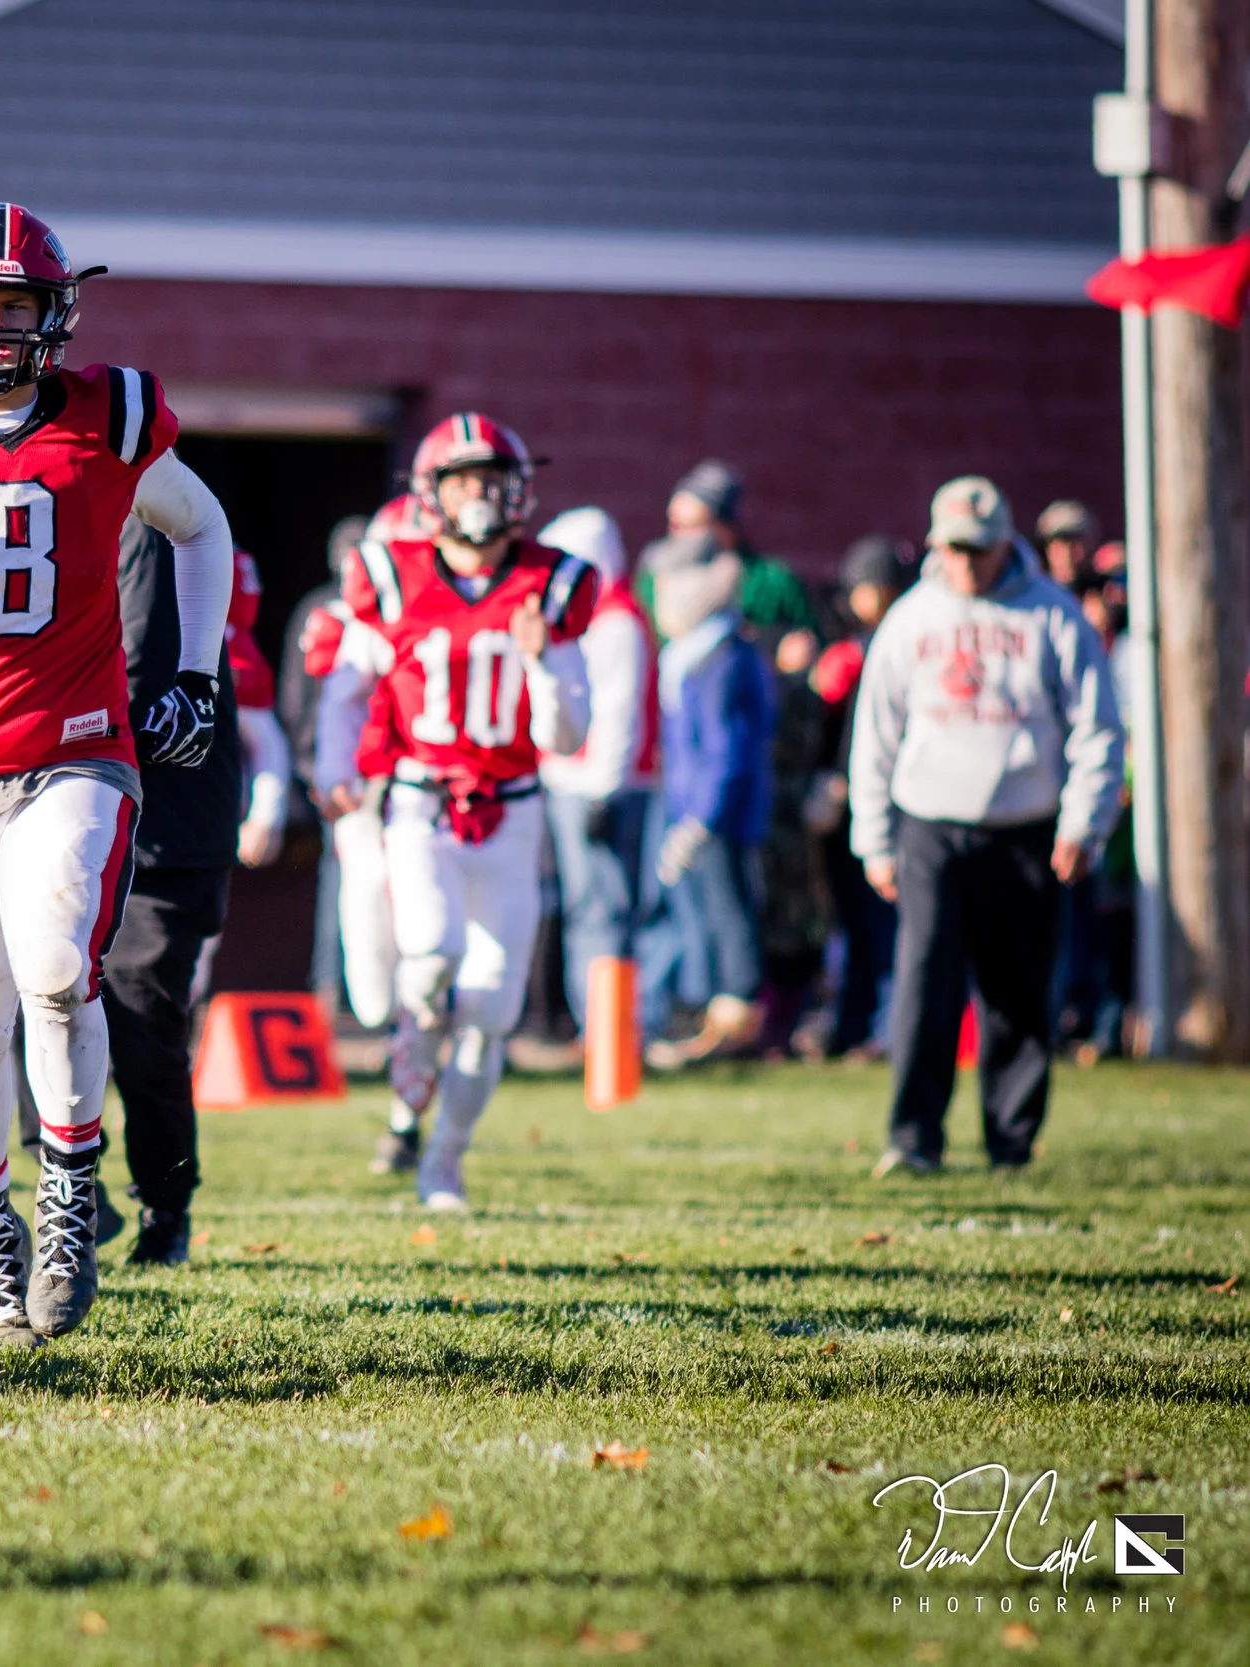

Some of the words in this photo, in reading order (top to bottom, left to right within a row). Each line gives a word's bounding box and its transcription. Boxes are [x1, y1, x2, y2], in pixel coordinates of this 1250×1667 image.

[69, 716, 104, 733] Riddell
[411, 626, 525, 748] 10
[250, 1008, 319, 1090] G
